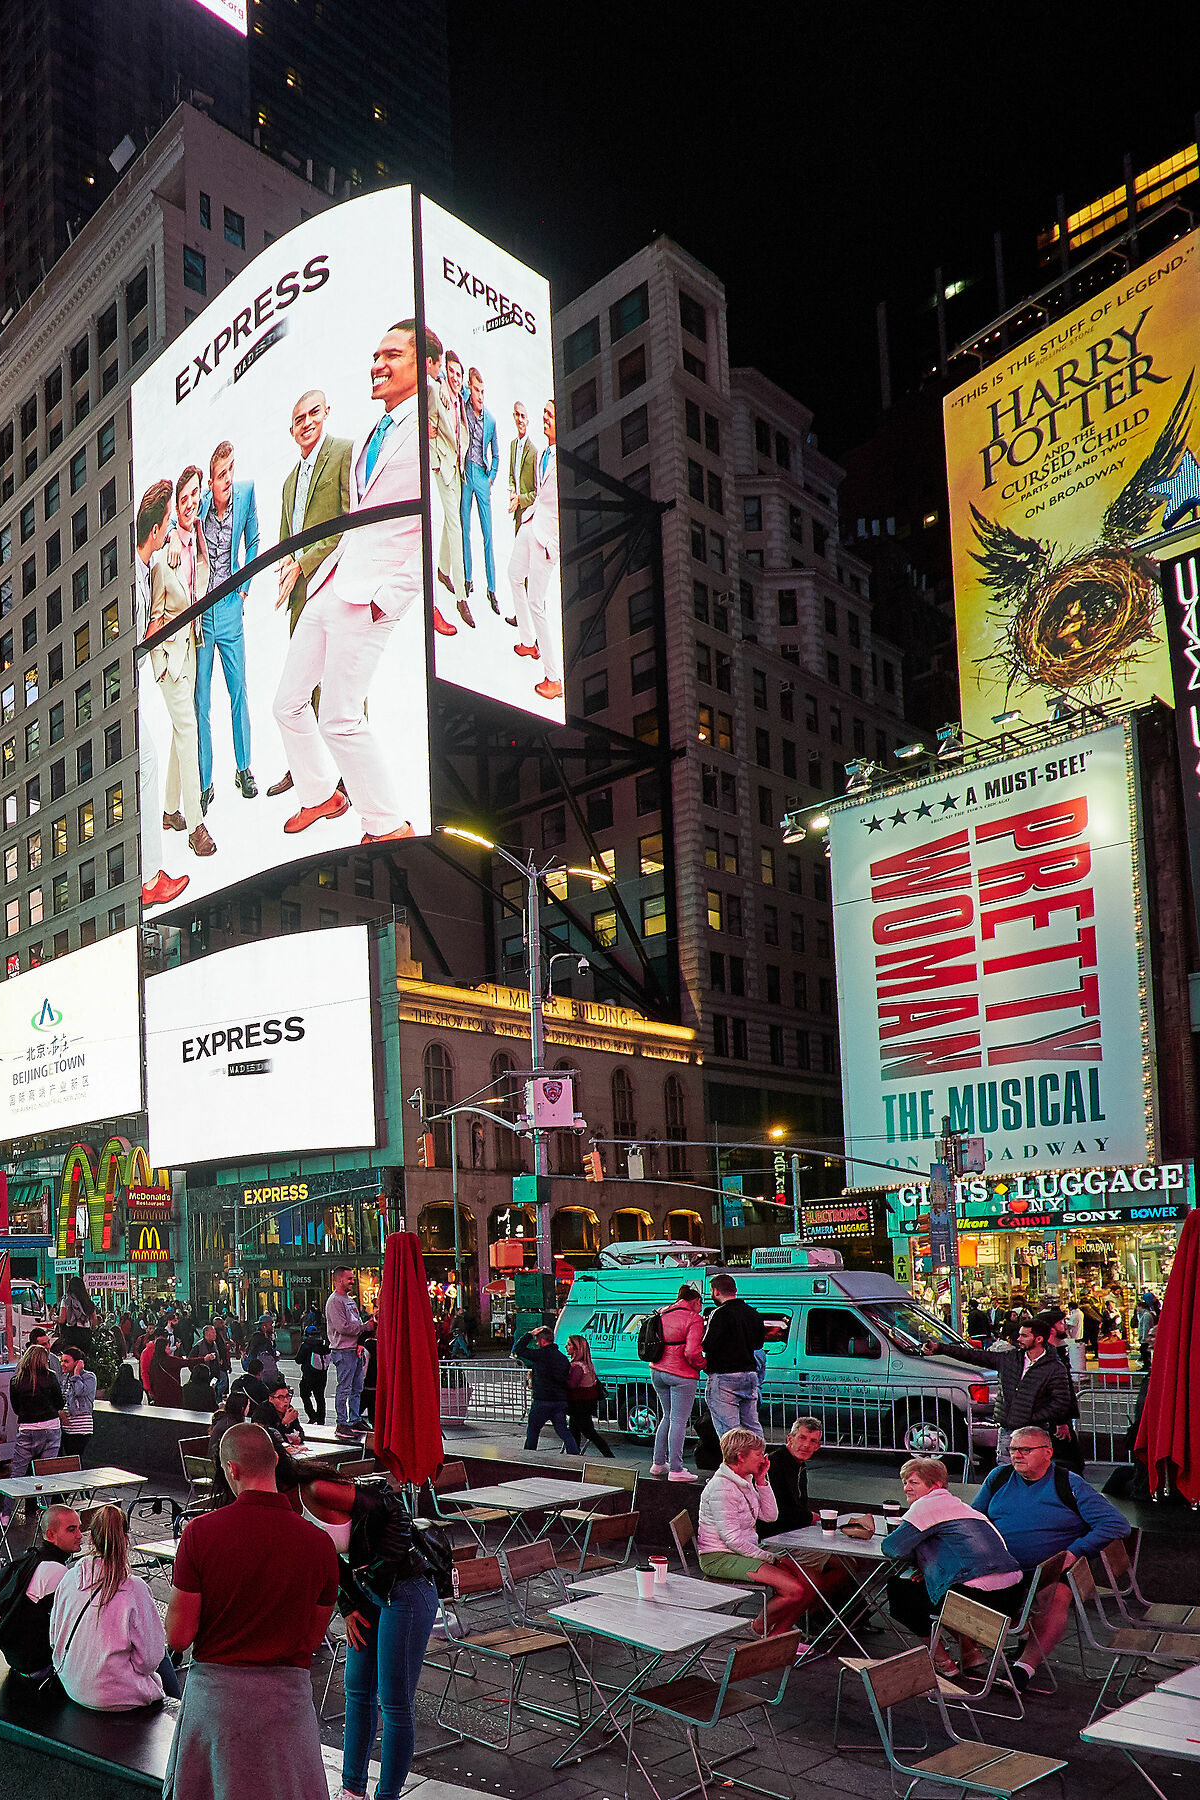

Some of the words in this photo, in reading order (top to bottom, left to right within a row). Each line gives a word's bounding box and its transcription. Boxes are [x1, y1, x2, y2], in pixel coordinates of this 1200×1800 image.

[443, 256, 536, 335] EXPRESS
[175, 254, 331, 406] EXPRESS
[992, 373, 1003, 388] IS
[1007, 353, 1036, 375] THE
[1040, 320, 1086, 356] STUFF
[1090, 302, 1112, 323] OF
[1035, 344, 1067, 368] ROLLING
[1069, 325, 1094, 348] STONE
[987, 305, 1153, 443] HARRY
[979, 355, 1172, 492] POTTER
[1001, 450, 1075, 500] CURSED
[1082, 408, 1150, 454] CHILD
[1044, 442, 1070, 462] AND
[1072, 426, 1096, 444] THE
[1021, 482, 1048, 502] PARTS
[1051, 469, 1072, 485] ONE
[1075, 455, 1098, 472] AND
[1101, 438, 1128, 457] TWO
[1025, 502, 1046, 519] ON
[1049, 457, 1126, 507] BROADWAY
[965, 786, 978, 807] A
[975, 795, 1103, 1066] PRETTY
[870, 828, 982, 1081] WOMAN
[414, 1010, 433, 1023] THE
[435, 1014, 464, 1027] SHOW
[468, 1019, 496, 1034] FOLKS
[508, 990, 560, 1014] MILER
[571, 1001, 628, 1025] BUILDING
[182, 1016, 306, 1063] EXPRESS
[882, 1089, 936, 1144] THE
[948, 1068, 1106, 1134] MUSICAL
[886, 1156, 919, 1169] ON
[129, 1193, 171, 1201] McDonald's
[244, 1183, 309, 1205] EXPRESS
[898, 1180, 988, 1207] GITS
[1015, 1164, 1184, 1200] LUGGAGE
[1028, 1197, 1064, 1213] NY
[805, 1207, 868, 1223] ELECTRONICS
[806, 1225, 834, 1236] CAMERA
[837, 1222, 870, 1233] LUGGAGE
[997, 1214, 1054, 1228] Canon
[1062, 1210, 1122, 1224] SONY
[1130, 1206, 1178, 1219] BOWER
[897, 1257, 909, 1280] ATM
[1017, 1245, 1043, 1255] 1550
[1077, 1243, 1114, 1254] BROADWAY
[286, 1276, 312, 1284] EXPRESS
